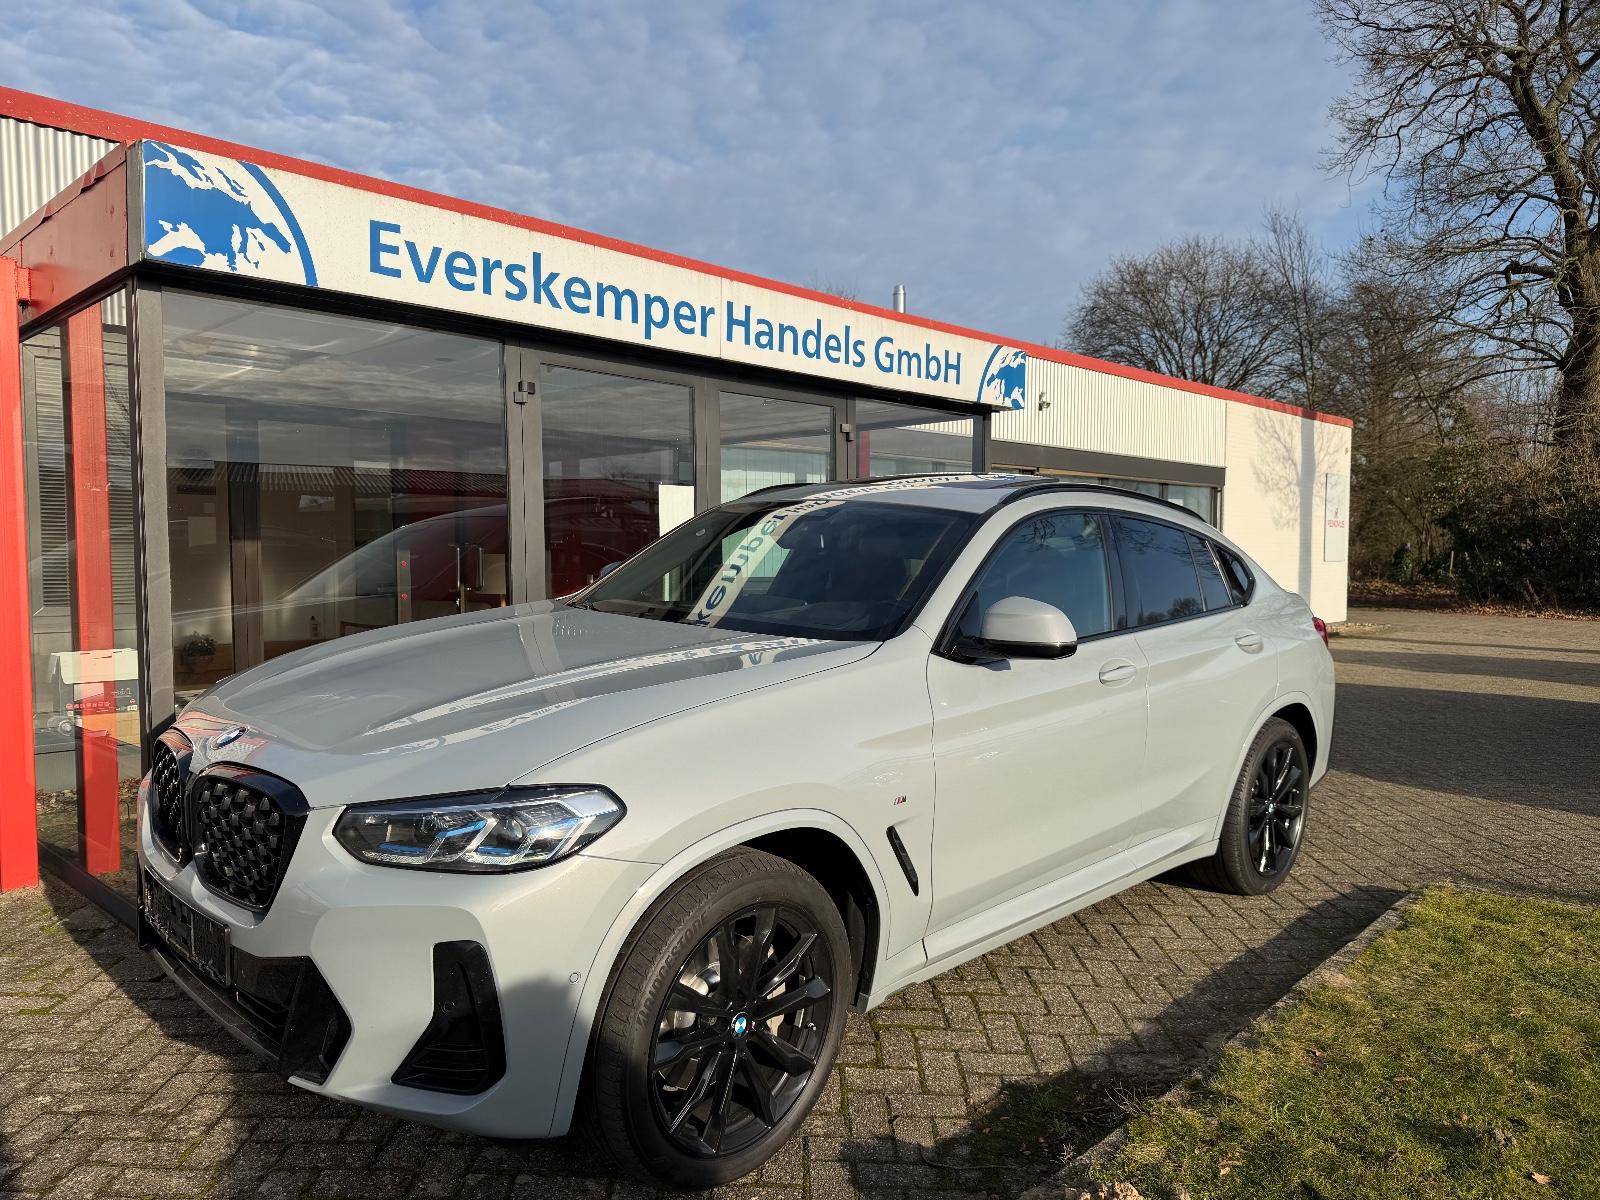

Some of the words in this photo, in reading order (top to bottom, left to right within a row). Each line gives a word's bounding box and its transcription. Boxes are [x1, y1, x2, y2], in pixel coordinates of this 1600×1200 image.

[369, 220, 715, 340] Everskemper
[726, 301, 865, 368] Handels
[874, 337, 961, 384] GmbH
